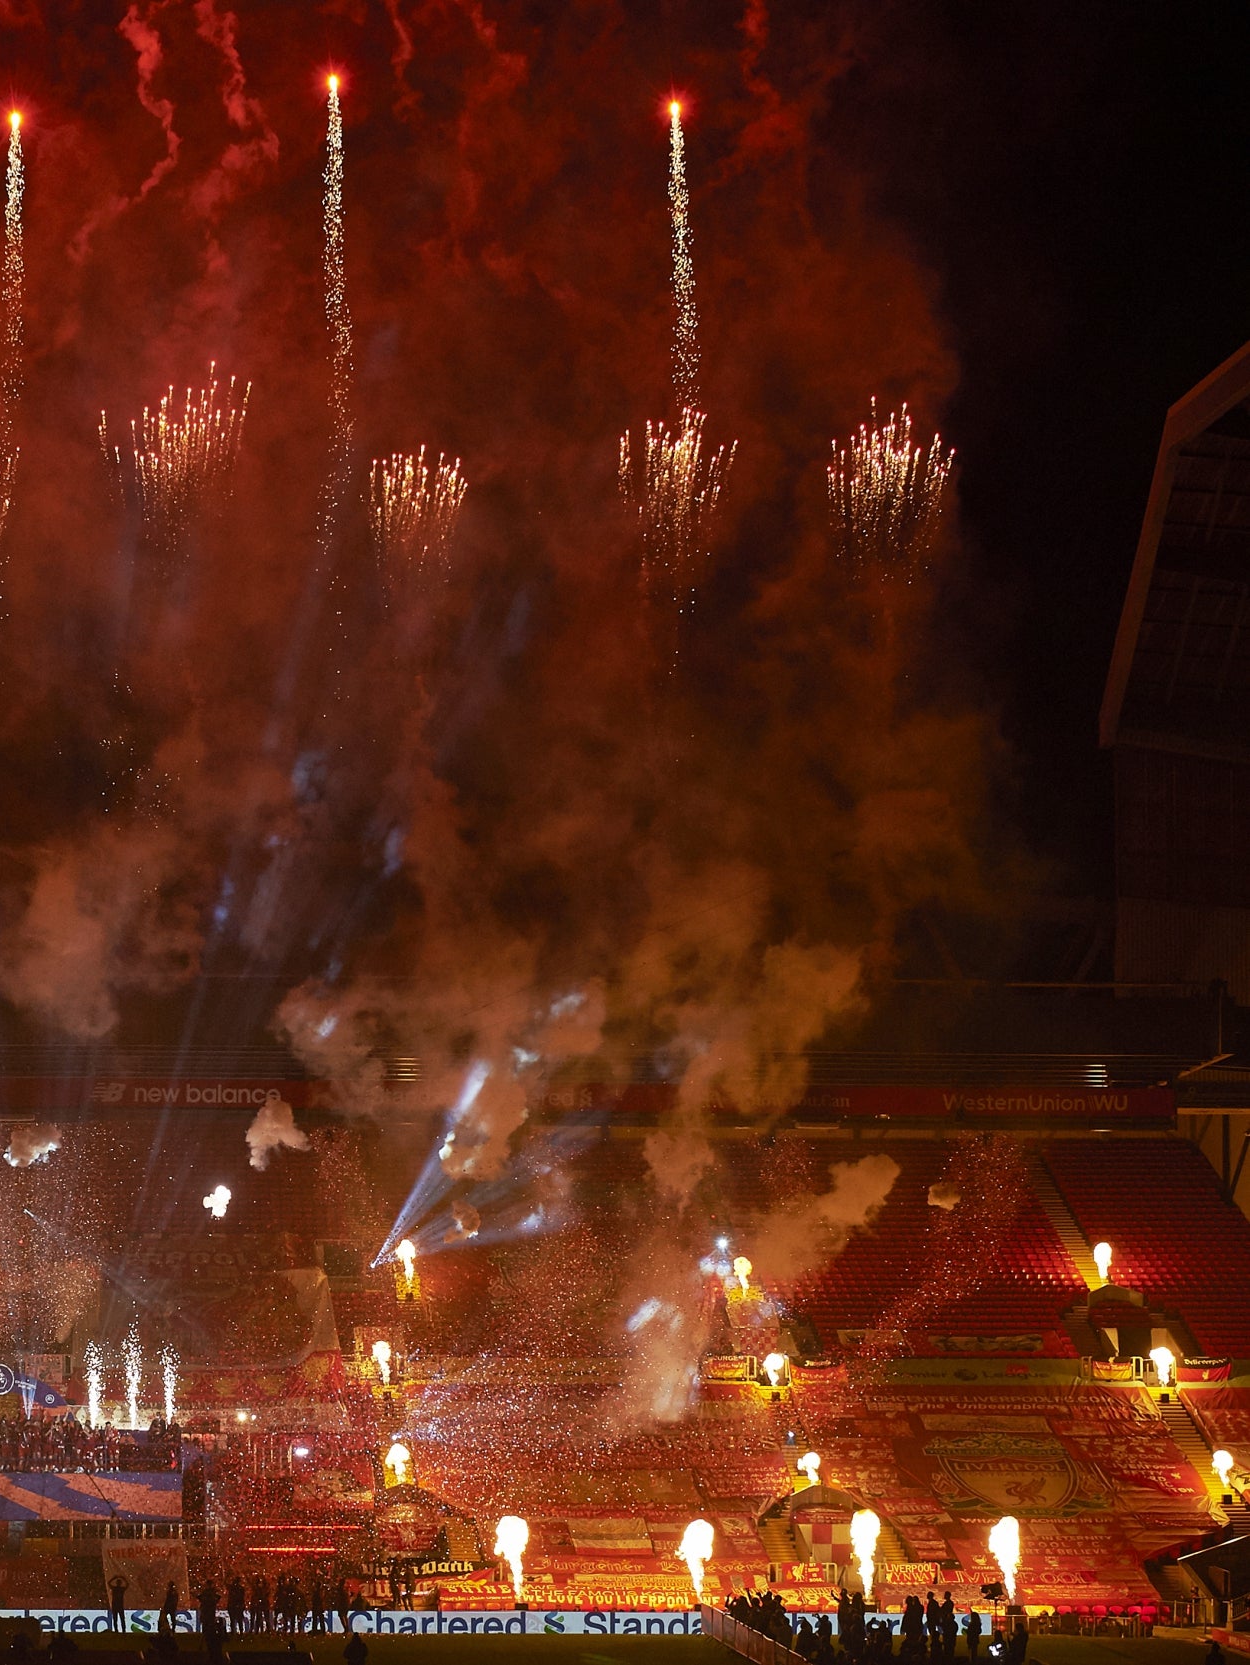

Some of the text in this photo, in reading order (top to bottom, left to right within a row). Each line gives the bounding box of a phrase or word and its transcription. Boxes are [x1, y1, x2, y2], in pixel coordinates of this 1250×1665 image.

[134, 1084, 281, 1104] new balance
[821, 1095, 850, 1108] Can
[942, 1094, 1129, 1112] WesternUnion WU
[953, 1463, 1066, 1471] LIVERPOOL
[885, 1563, 935, 1573] LIVERPOOL
[894, 1572, 929, 1582] YNWA
[940, 1570, 1087, 1584] LIVEPOOL
[531, 1589, 564, 1597] THE
[522, 1595, 545, 1603] WE
[547, 1595, 584, 1605] LOVE
[588, 1595, 614, 1605] YOU
[616, 1595, 693, 1607] LIVERPOOL
[348, 1610, 526, 1634] Chartered
[583, 1612, 702, 1635] Standa
